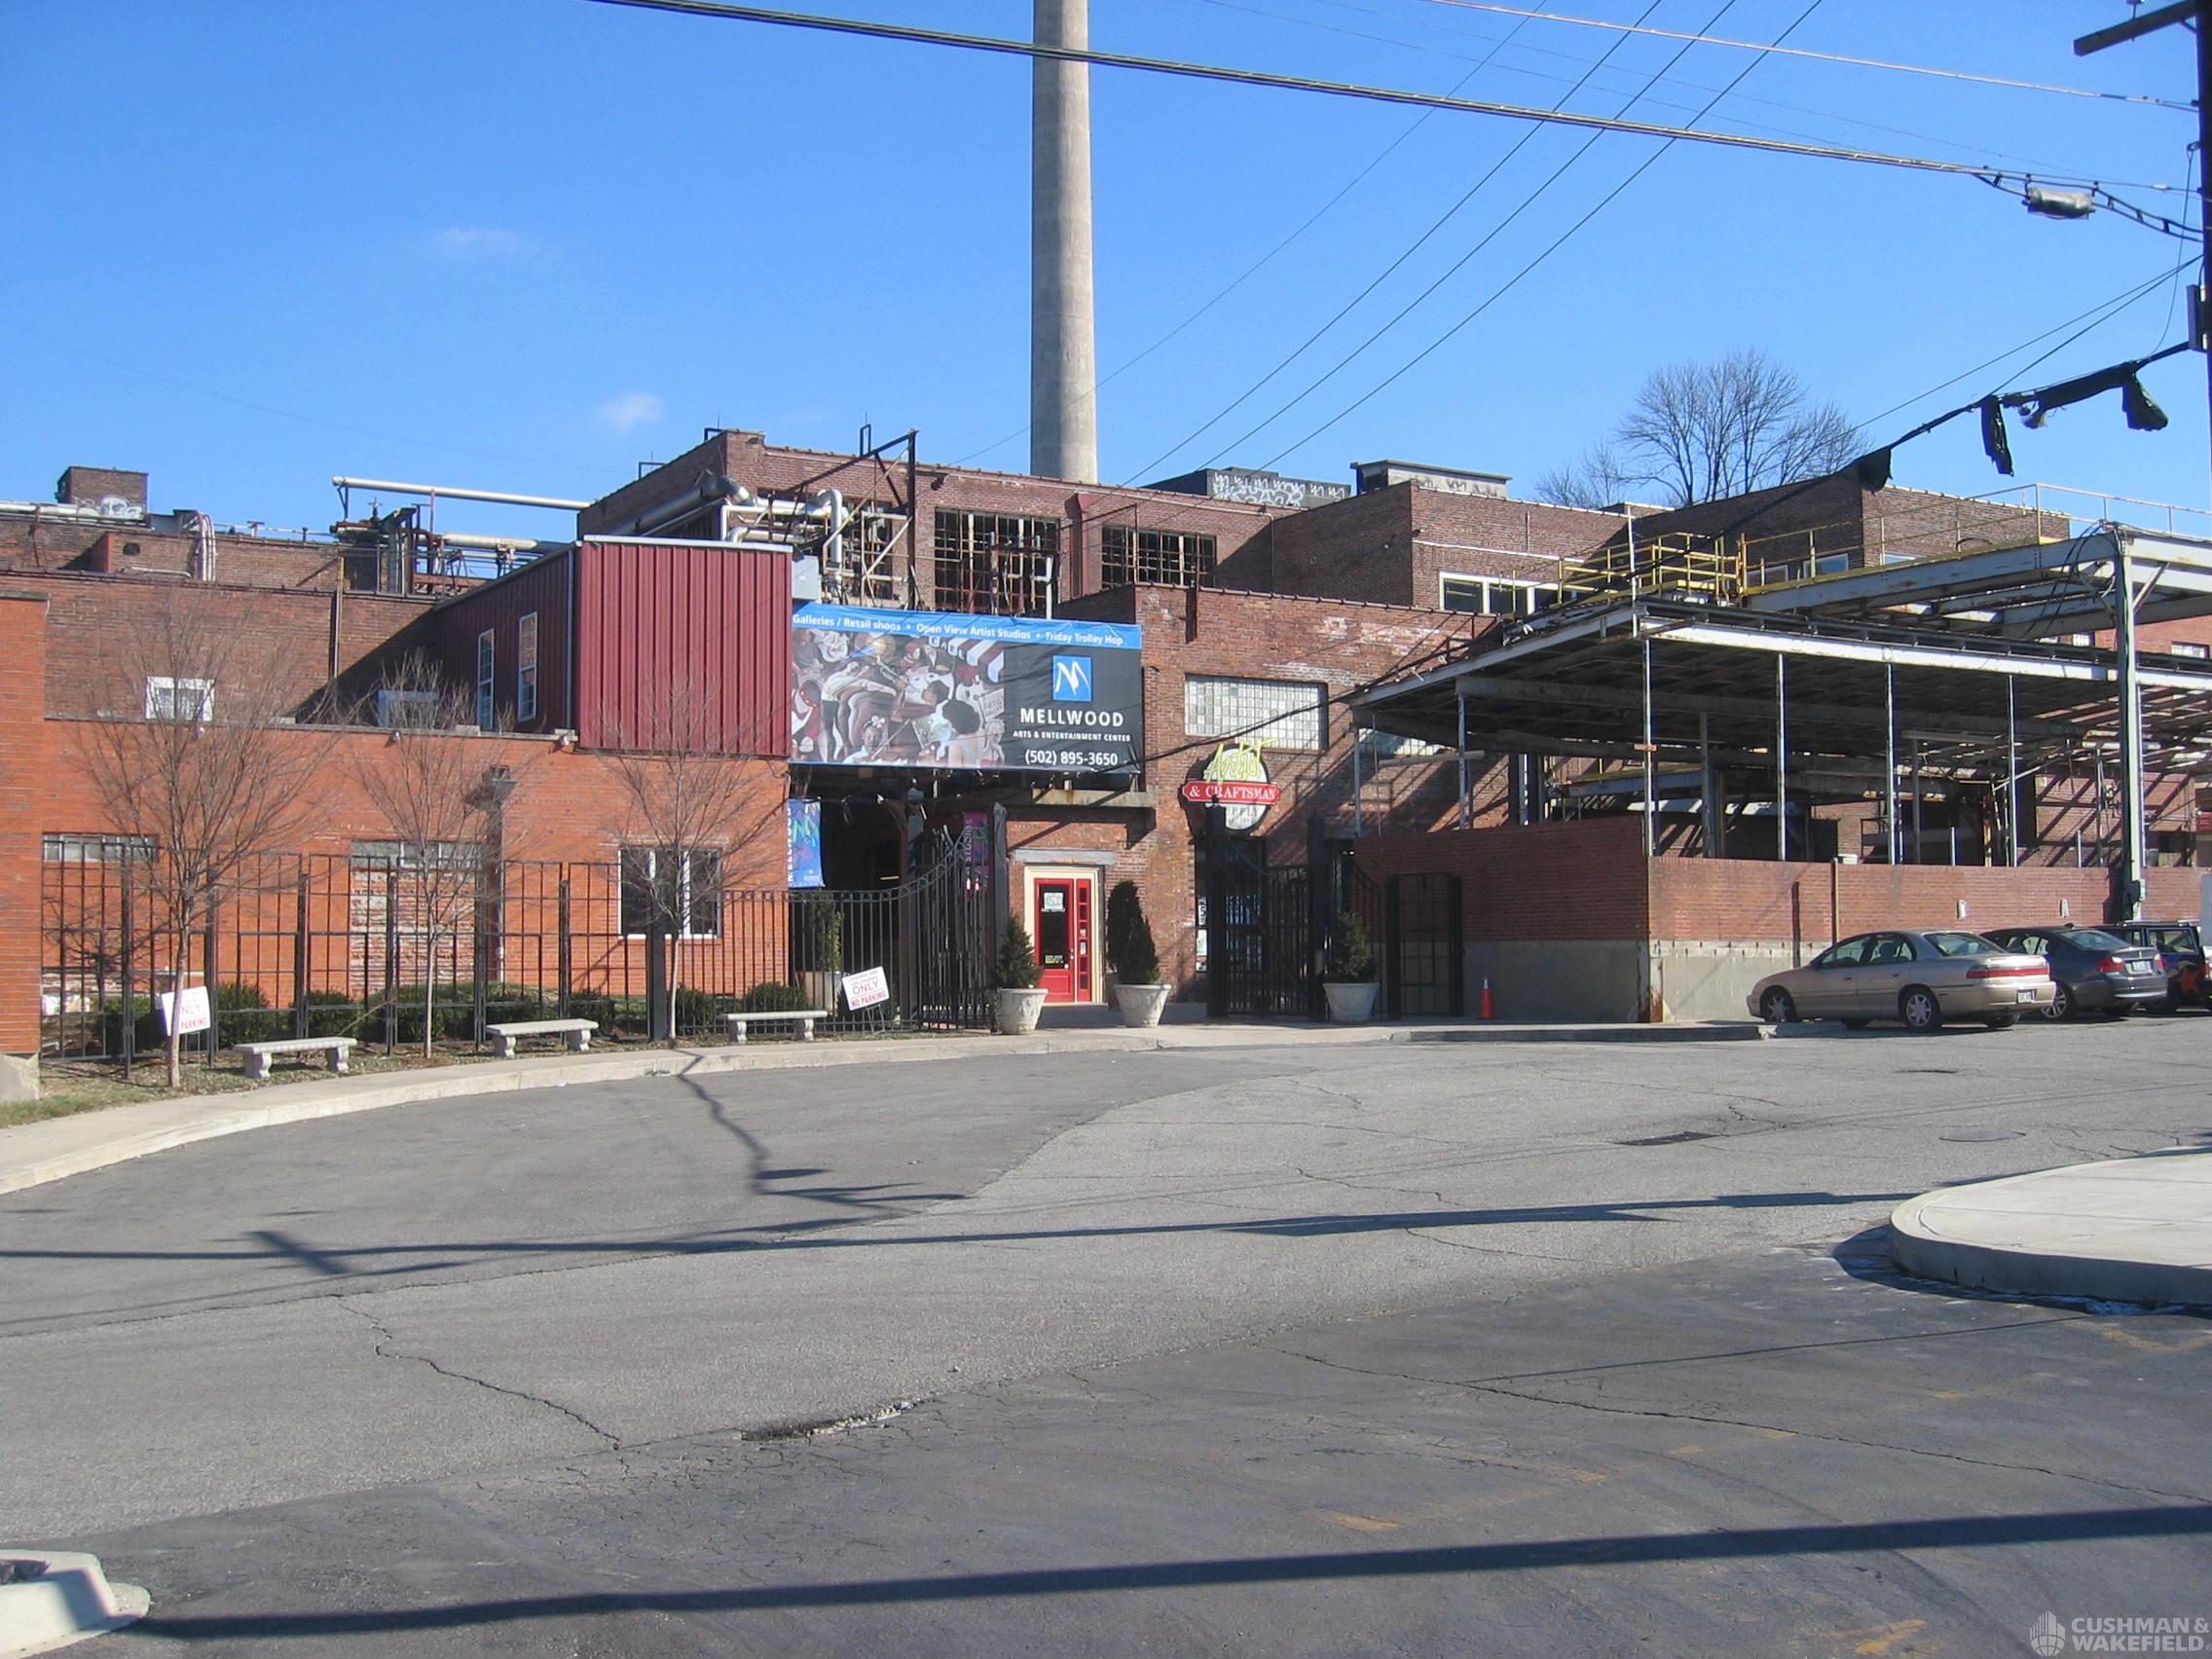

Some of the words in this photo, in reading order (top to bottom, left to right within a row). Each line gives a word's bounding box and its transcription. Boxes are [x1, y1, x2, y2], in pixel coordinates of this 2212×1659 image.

[793, 614, 834, 626] Galleries
[843, 618, 871, 630] Retail
[873, 621, 902, 632] shops
[916, 623, 941, 634] Open
[944, 625, 968, 635] View
[970, 628, 996, 638] Artist
[998, 630, 1031, 640] Studios
[1075, 633, 1103, 645] Trolley
[1105, 636, 1124, 646] Hop
[1019, 708, 1124, 727] MELLWOOD
[1013, 730, 1032, 739] ARTS
[1033, 730, 1040, 739] &
[1041, 731, 1102, 741] ENTERTAINMENT
[1103, 733, 1131, 742] CENTER
[1025, 749, 1057, 765] (502)
[1060, 751, 1119, 765] 895-3650
[1189, 785, 1200, 797] &
[1205, 786, 1276, 800] CRAFTSMAN
[852, 979, 879, 995] ONLY
